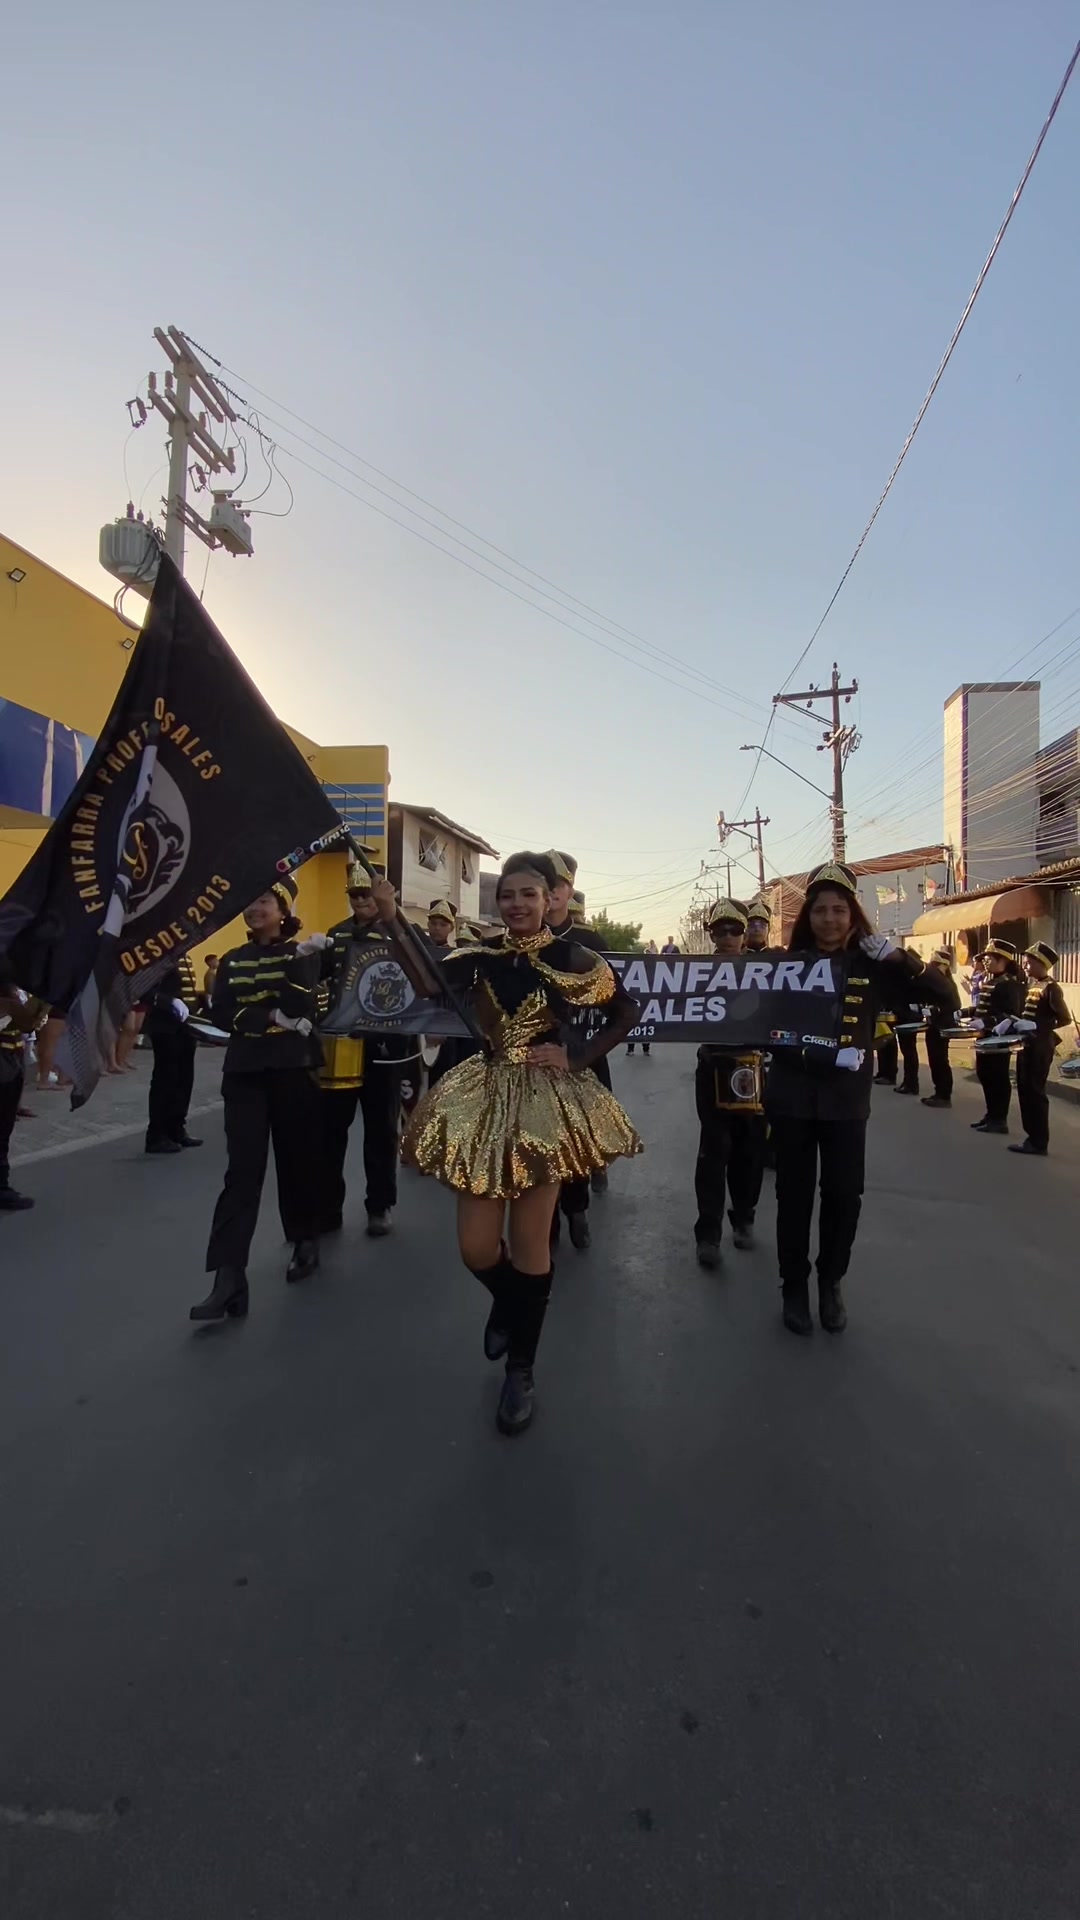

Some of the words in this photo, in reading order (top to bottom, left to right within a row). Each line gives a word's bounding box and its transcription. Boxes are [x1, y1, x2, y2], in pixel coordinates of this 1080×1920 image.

[71, 793, 104, 913] FANFARRA
[121, 921, 188, 973] DESDE
[187, 874, 231, 924] 2013
[637, 996, 726, 1023] ALES
